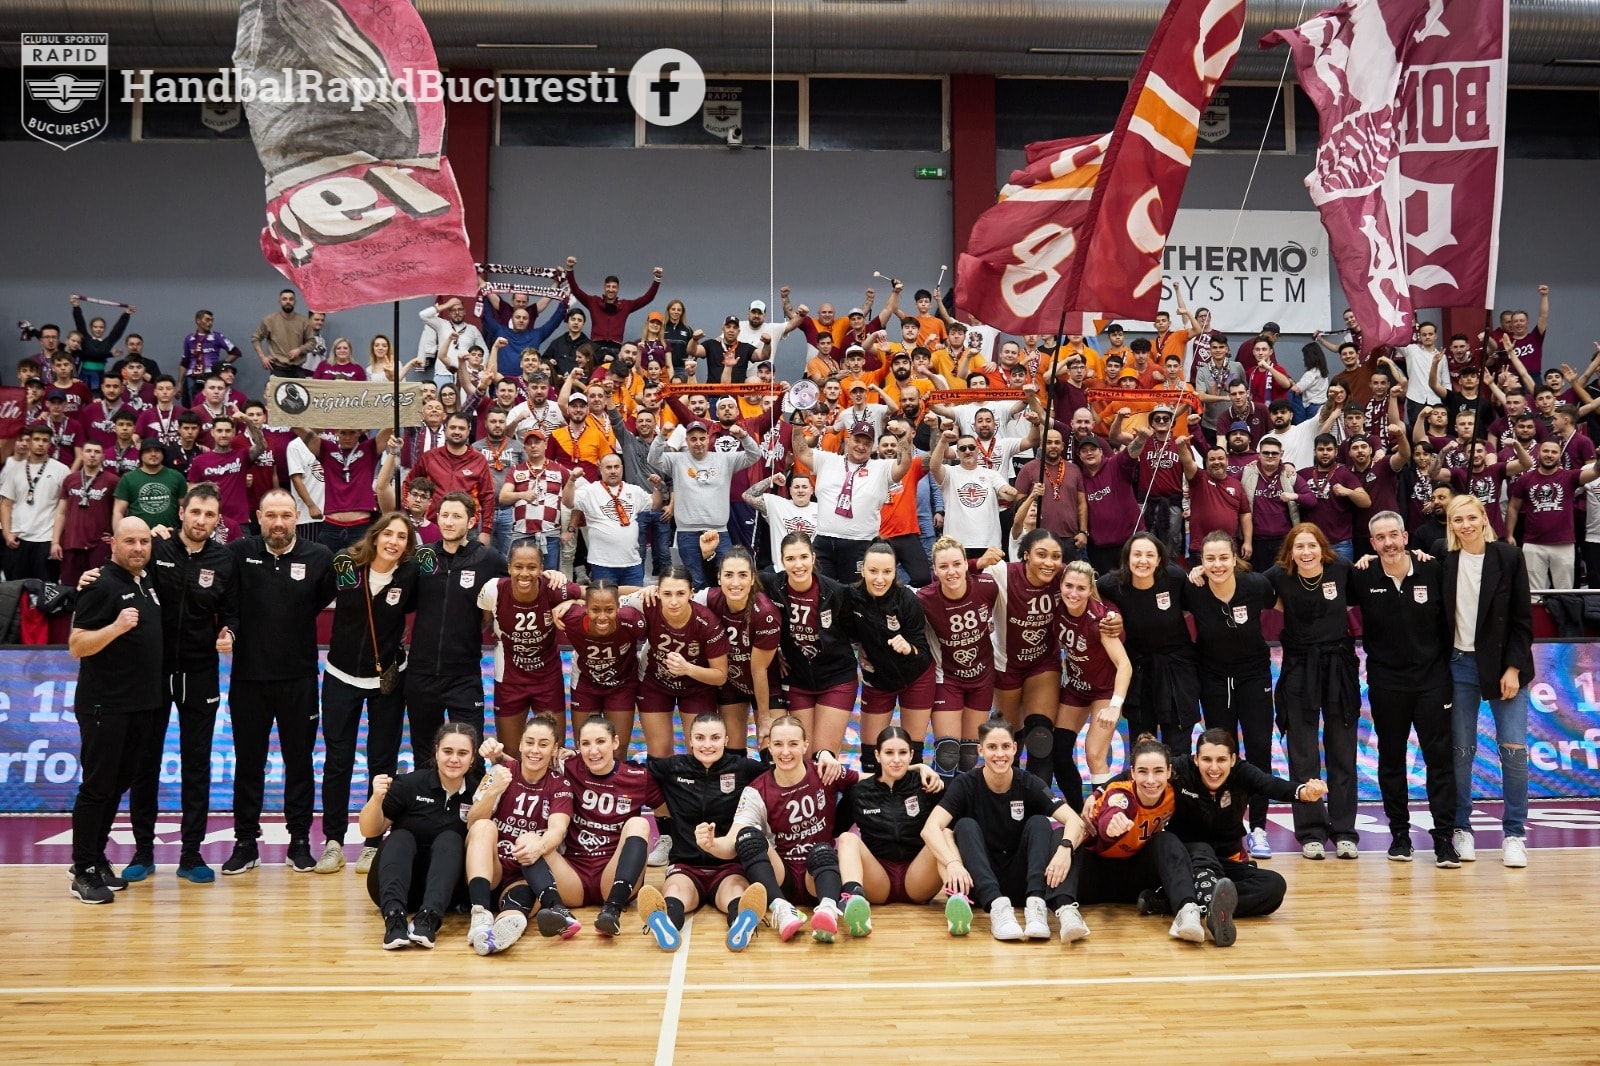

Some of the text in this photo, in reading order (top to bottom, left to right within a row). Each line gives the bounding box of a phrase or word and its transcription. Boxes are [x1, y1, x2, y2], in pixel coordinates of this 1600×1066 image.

[1162, 242, 1308, 275] THERMO
[1160, 275, 1306, 303] SYSTEM
[789, 603, 811, 625] 37
[1027, 594, 1052, 614] 10
[514, 612, 538, 631] 22
[950, 610, 978, 633] 88
[657, 633, 685, 653] 27
[727, 626, 738, 645] 2
[1058, 623, 1075, 647] 79
[586, 645, 617, 660] 21
[512, 792, 540, 817] 17
[582, 790, 614, 814] 90
[786, 795, 815, 824] 20
[1138, 817, 1161, 842] 12
